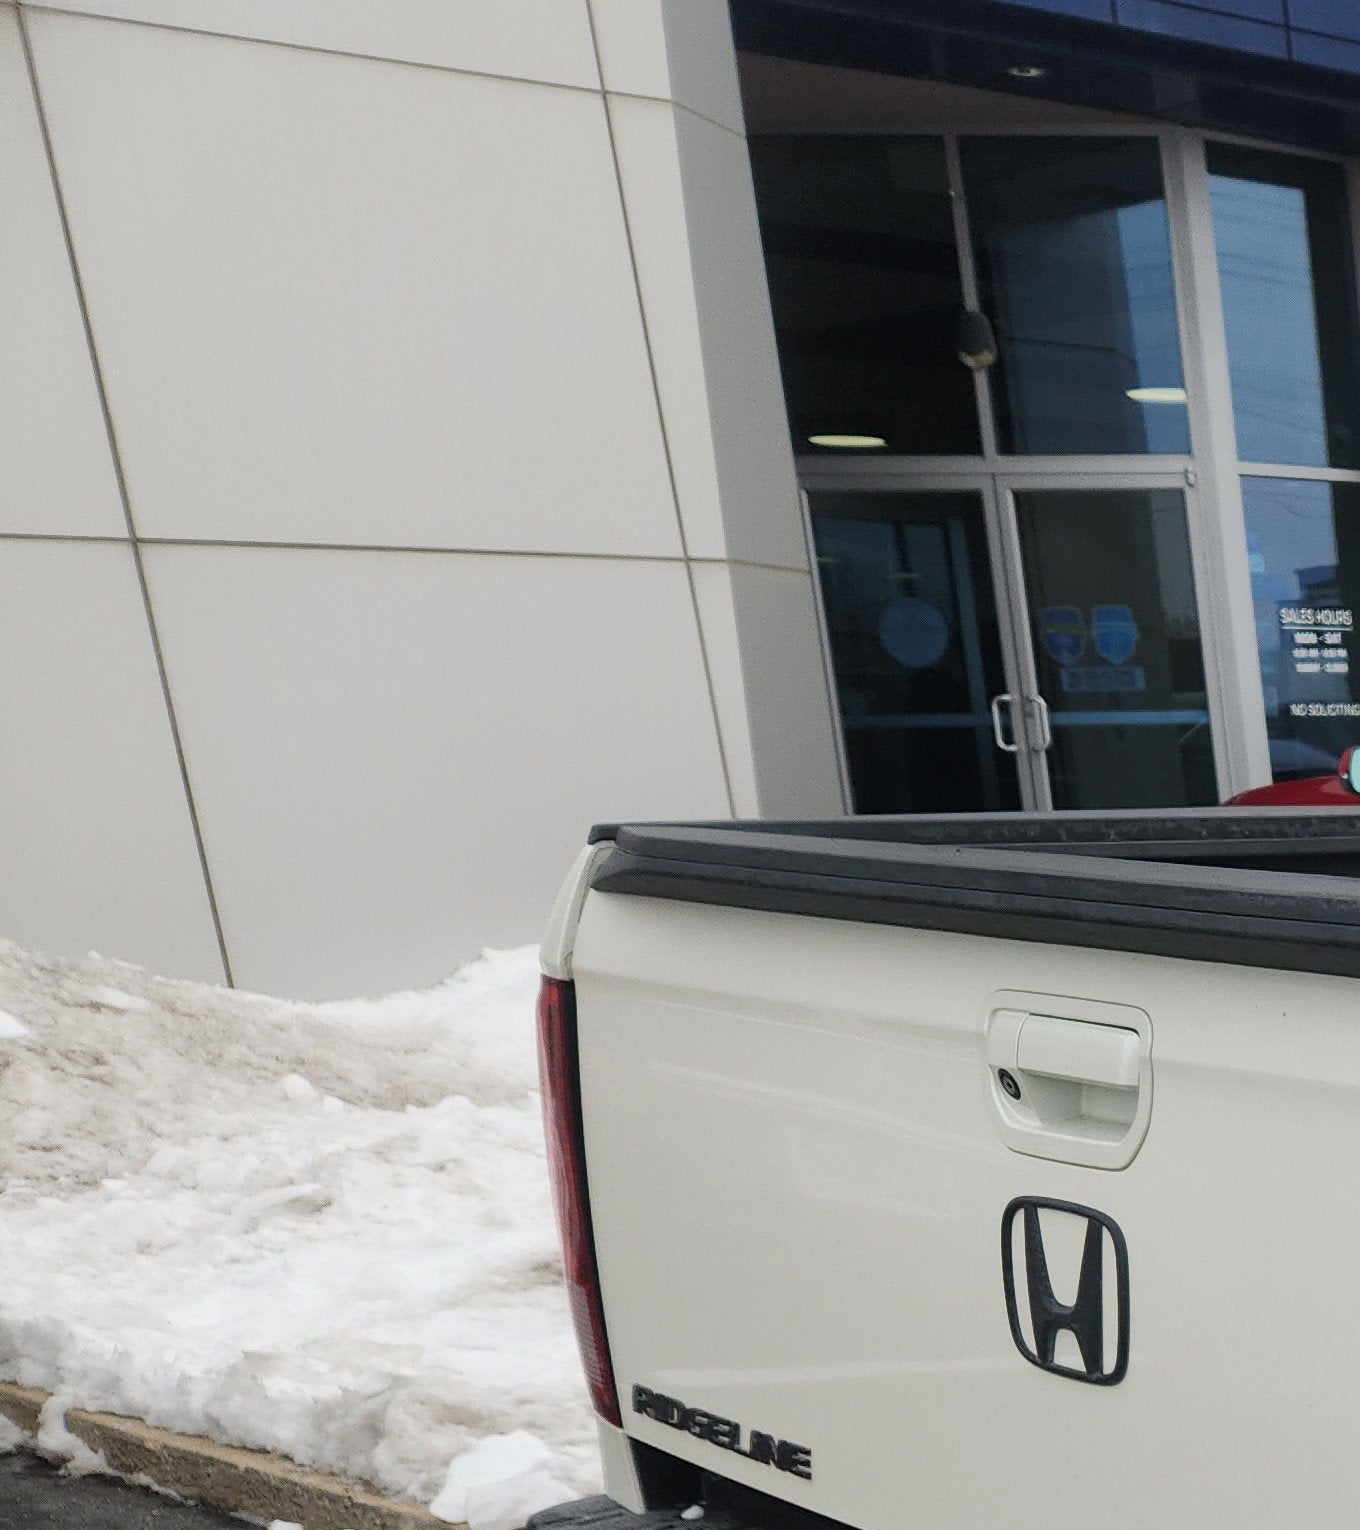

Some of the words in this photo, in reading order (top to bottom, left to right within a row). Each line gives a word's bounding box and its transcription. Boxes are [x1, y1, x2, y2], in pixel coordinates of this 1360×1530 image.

[1279, 607, 1315, 624] SALES
[1316, 609, 1353, 625] HOURS
[1290, 703, 1307, 716] NO
[632, 1383, 812, 1481] RIDGELINE
